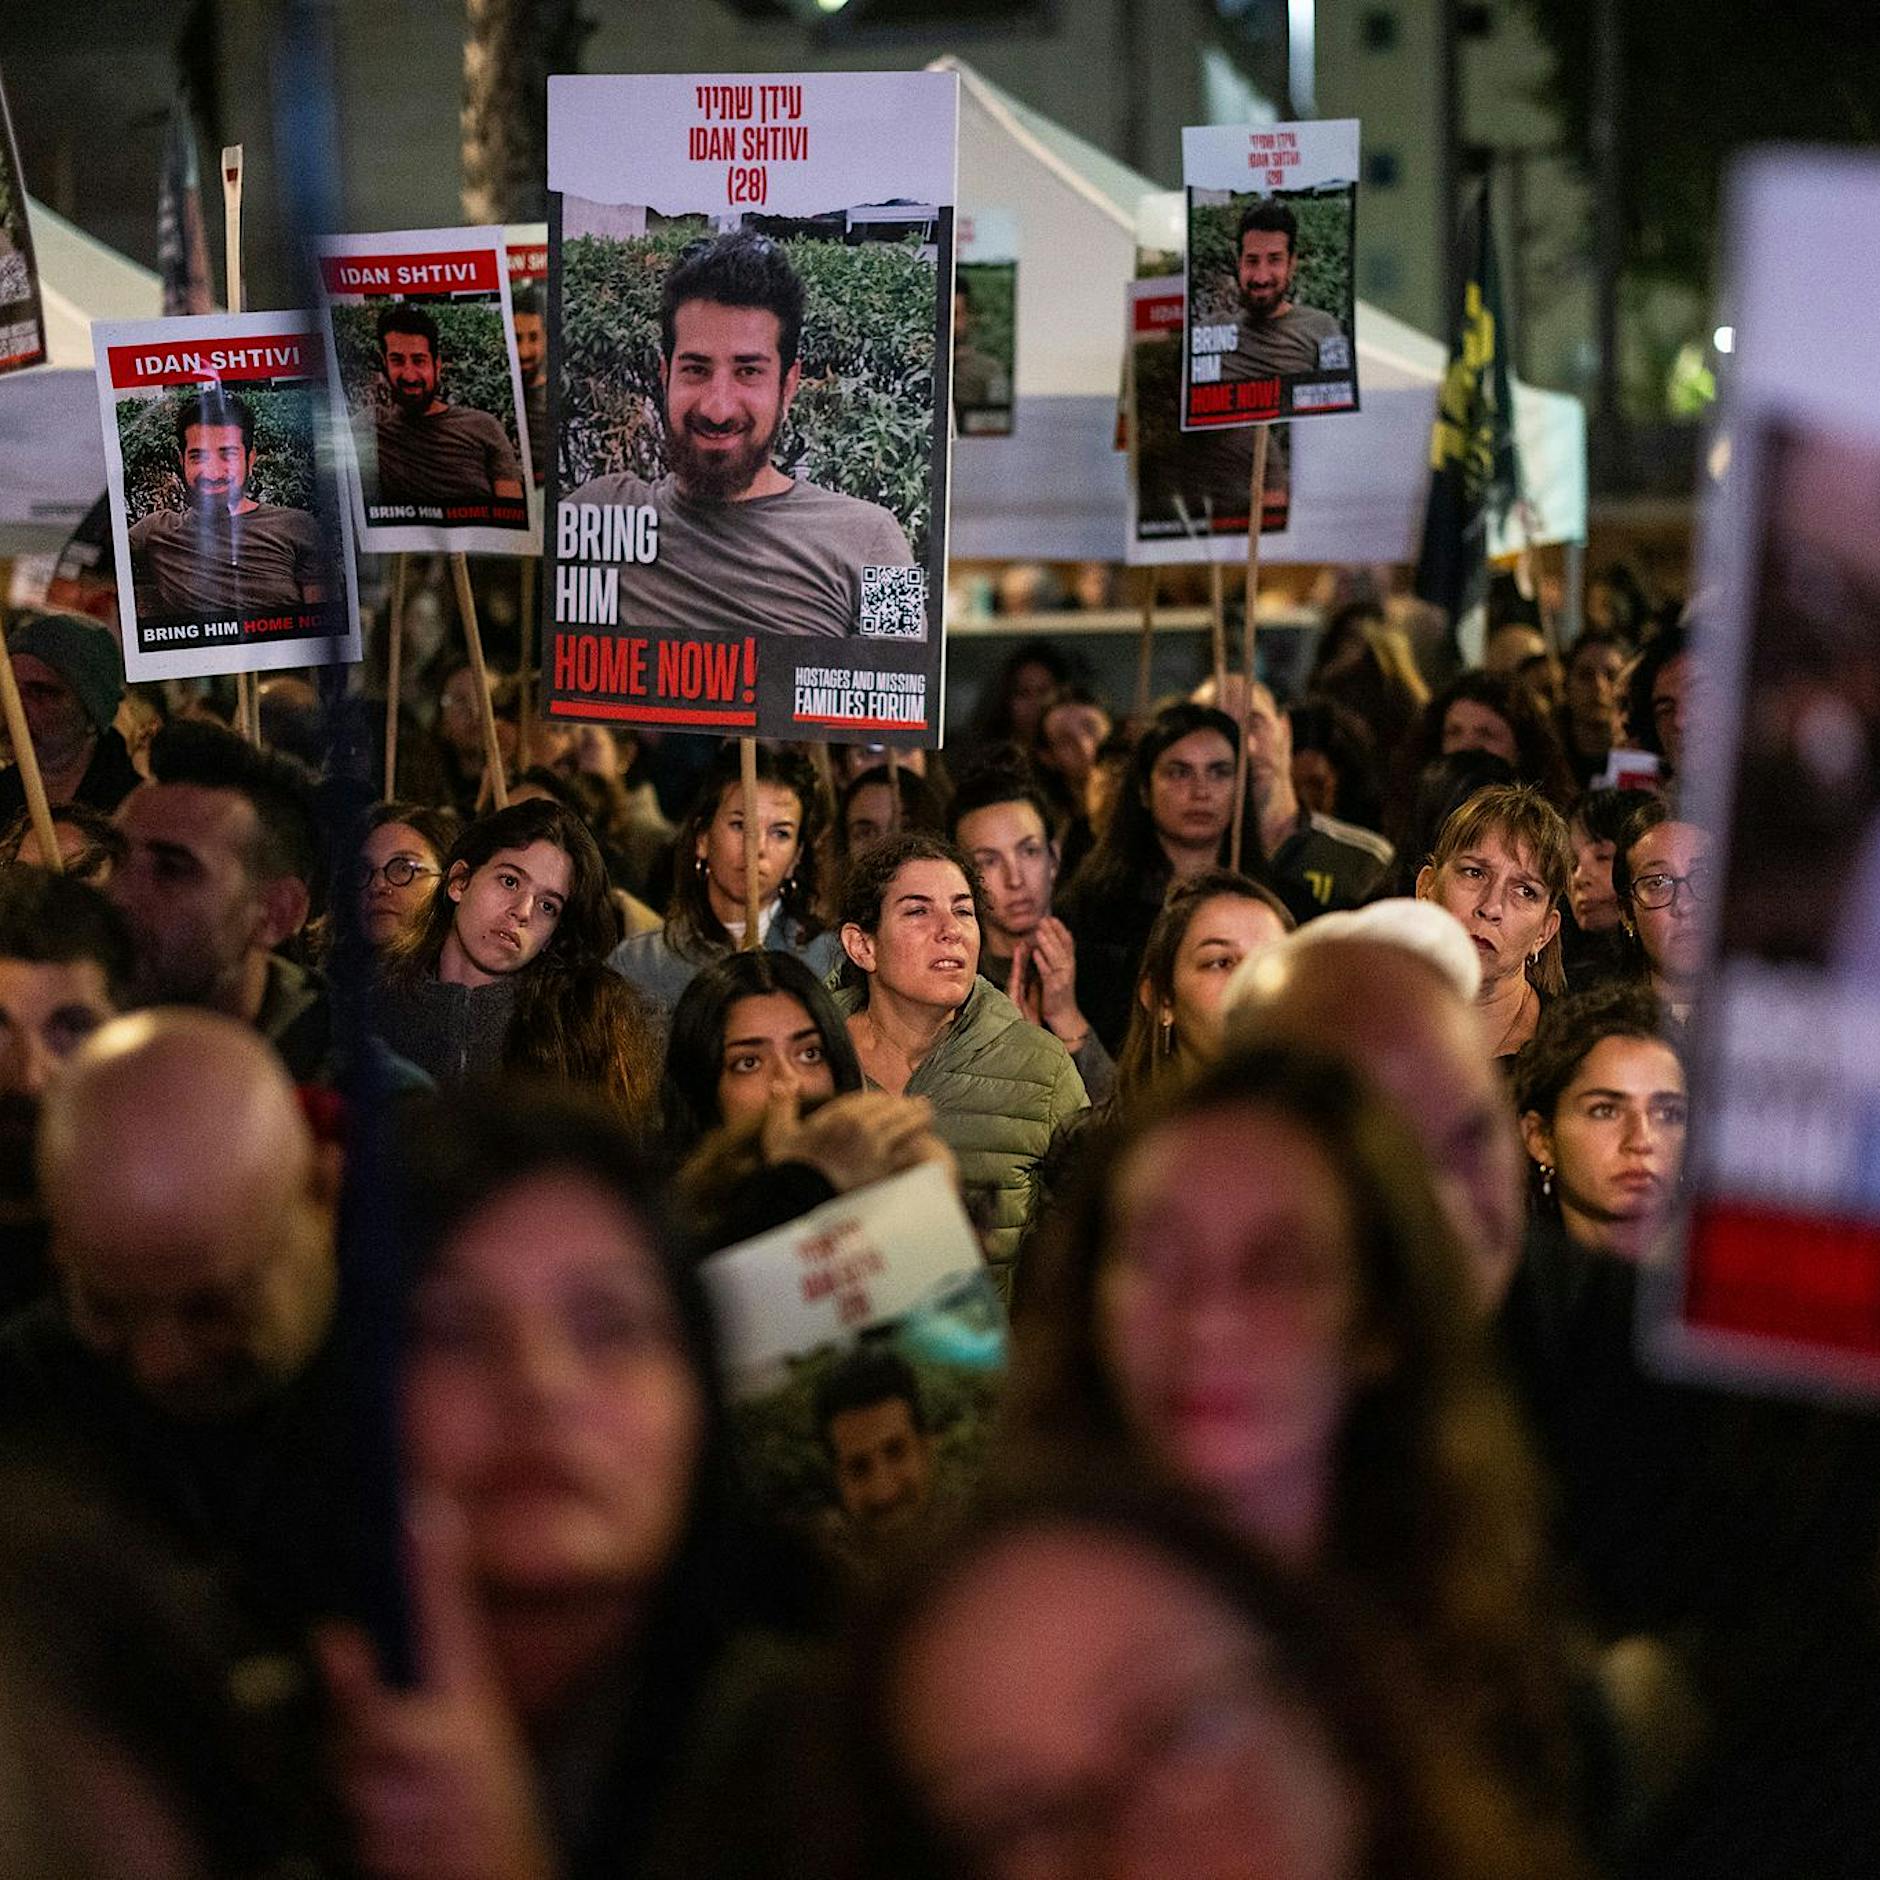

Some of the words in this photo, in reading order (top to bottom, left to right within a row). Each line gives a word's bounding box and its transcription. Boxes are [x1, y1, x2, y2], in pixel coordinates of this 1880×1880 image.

[695, 85, 753, 120] שתיוי
[759, 85, 802, 124] עידן
[688, 126, 736, 161] IDAN
[742, 126, 808, 161] SHTIVI
[727, 166, 768, 206] (28)
[339, 266, 391, 285] IDAN
[397, 262, 477, 285] SHTIVI
[1190, 323, 1239, 355] BRING
[134, 352, 201, 376] IDAN
[210, 347, 300, 370] SHTIVI
[369, 504, 416, 520] BRING
[418, 506, 444, 520] HIM
[557, 501, 659, 564] BRING
[555, 564, 619, 626] HIM
[142, 624, 200, 643] BRING
[204, 621, 239, 637] HIM
[243, 615, 293, 635] HOME
[299, 614, 322, 631] NO
[554, 632, 649, 696] HOME
[656, 635, 757, 704] NOW!
[794, 666, 850, 690] HOSTAGES
[851, 670, 875, 691] AND
[875, 671, 926, 694] MISSING
[794, 687, 866, 719] FAMILIES
[867, 691, 925, 724] FORUM
